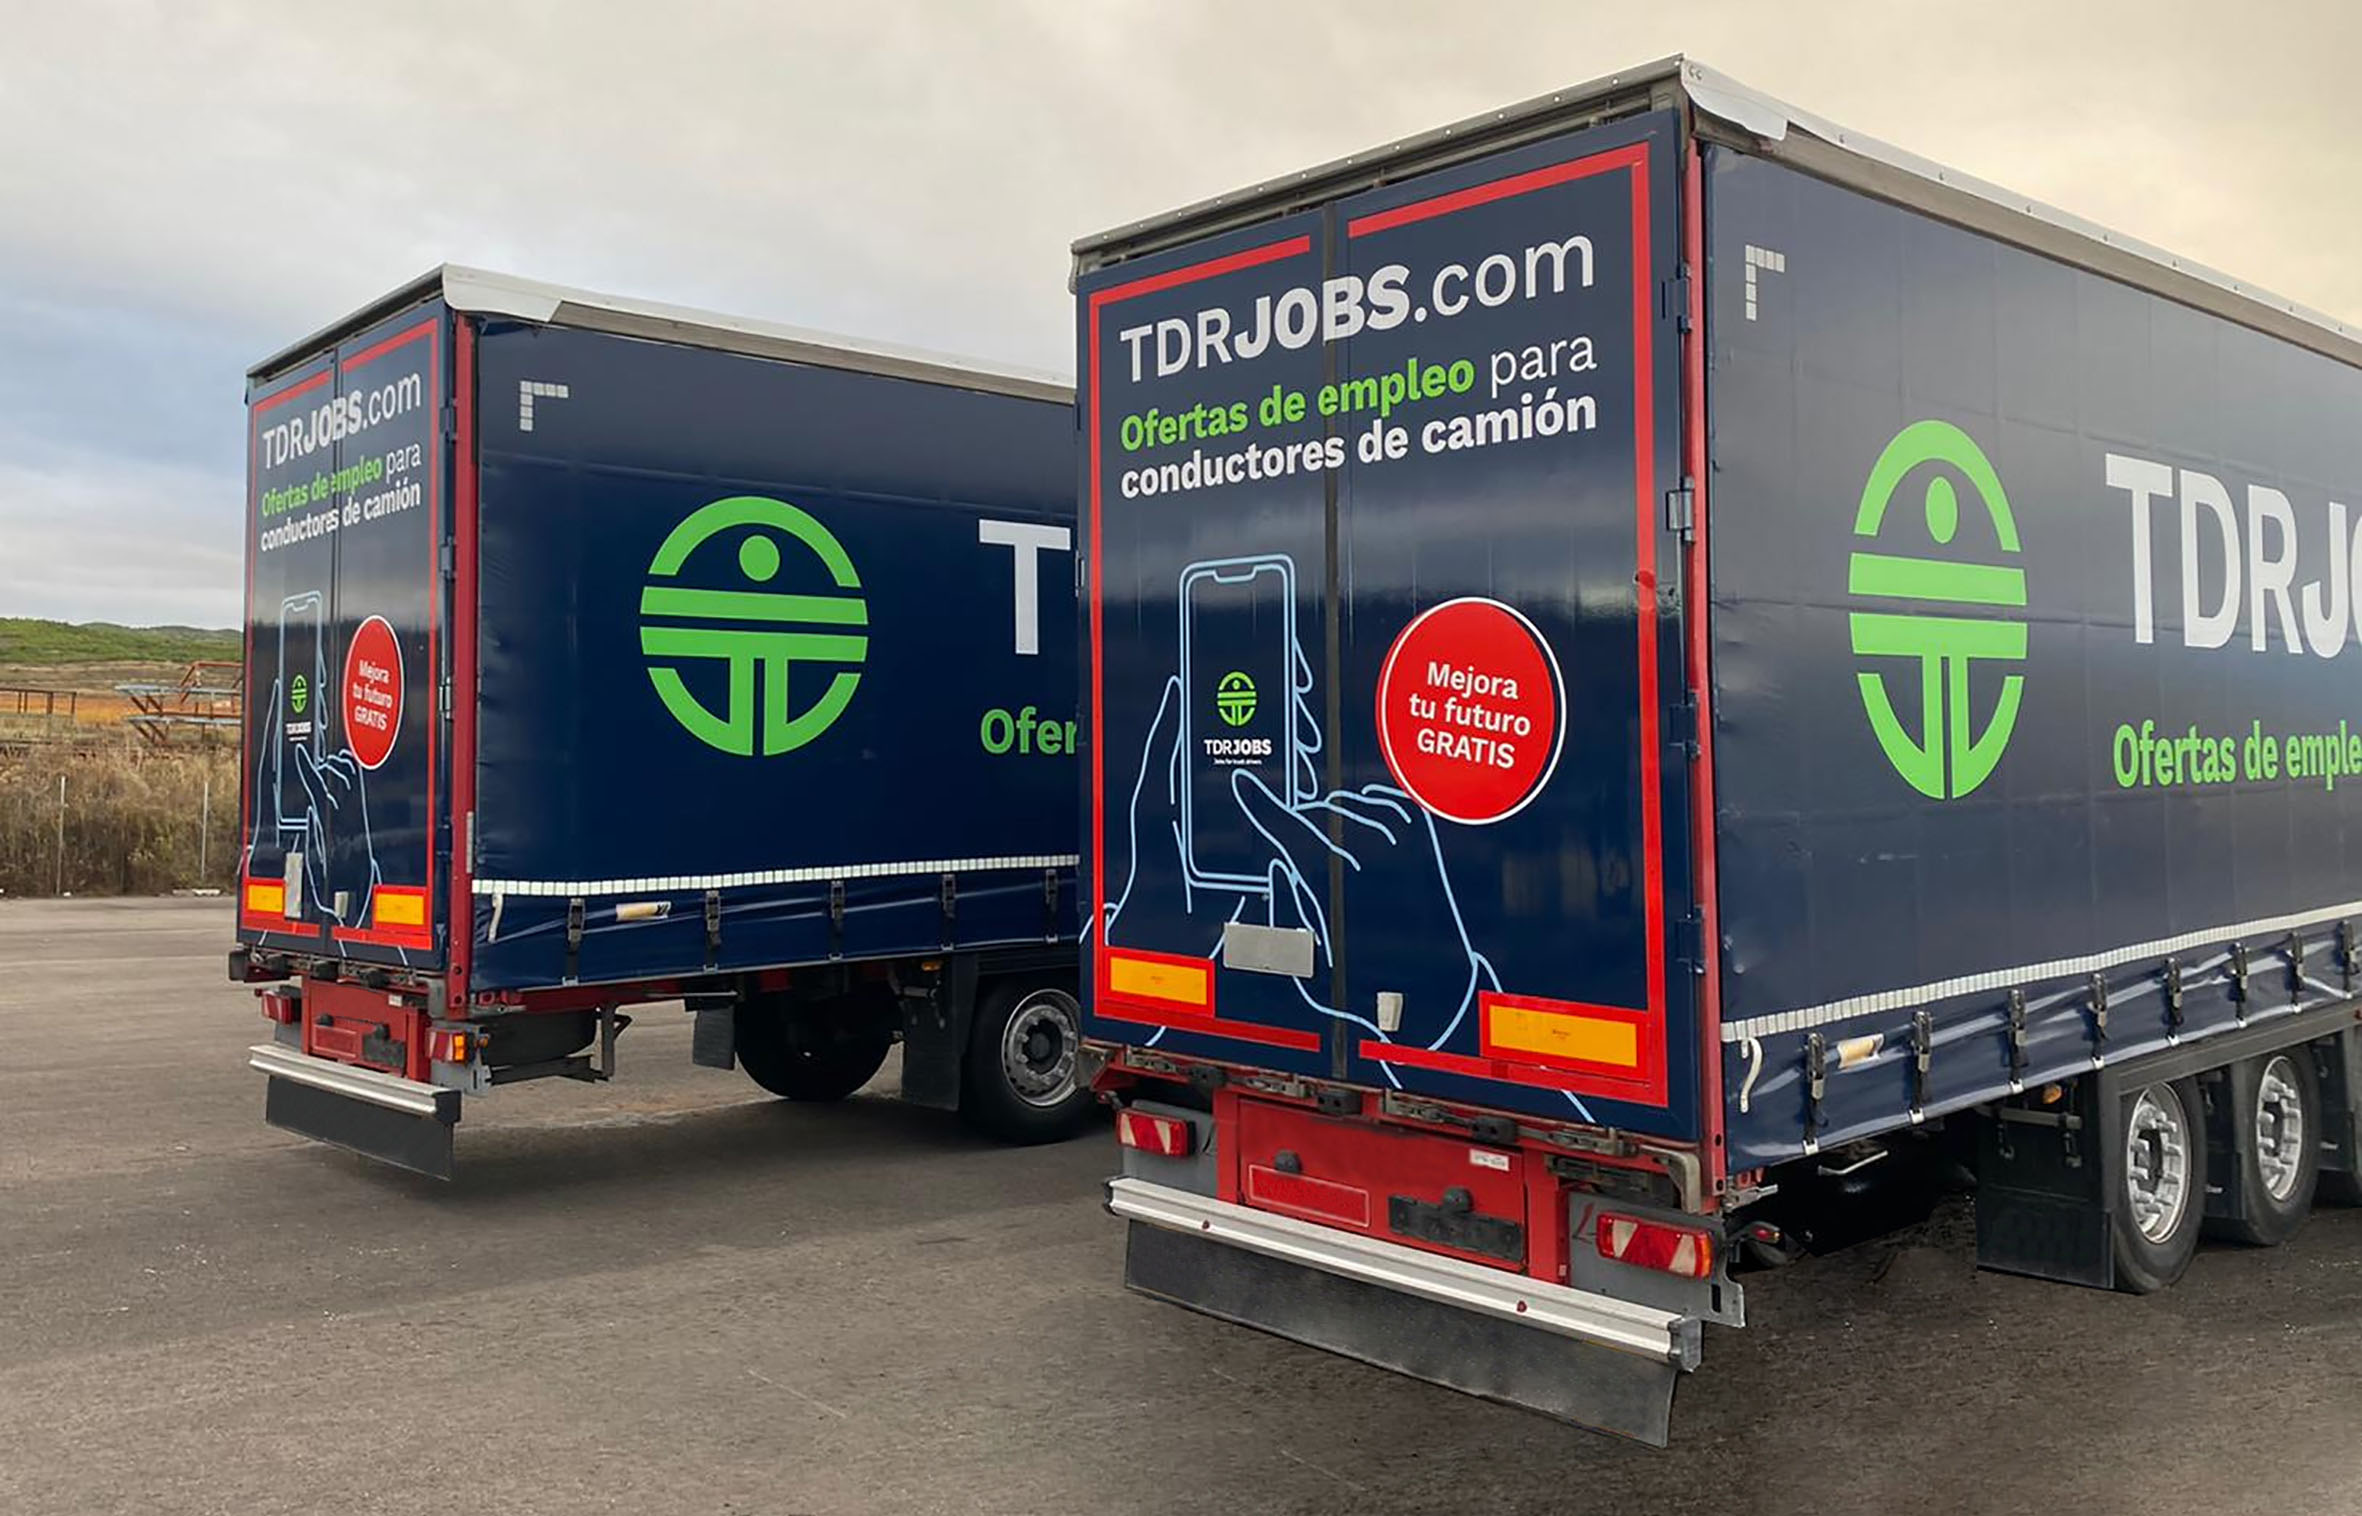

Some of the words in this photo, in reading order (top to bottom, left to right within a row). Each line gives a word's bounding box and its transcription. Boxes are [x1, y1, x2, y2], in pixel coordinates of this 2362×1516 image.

[1119, 234, 1595, 383] TDRJOBS.com
[262, 373, 421, 470] TDRJOBS.com
[1121, 402, 1248, 452] Ofertas
[1258, 385, 1307, 428] de
[1317, 359, 1477, 418] empleo
[1490, 336, 1598, 399] para
[262, 484, 308, 517] Ofertas
[311, 471, 330, 500] de
[331, 455, 382, 495] empleo
[386, 443, 421, 483] para
[1121, 438, 1345, 499] conductores
[1357, 419, 1409, 464] de
[1421, 387, 1597, 454] camión
[261, 507, 340, 552] conductores
[342, 496, 361, 527] de
[363, 477, 421, 520] camión
[2105, 453, 2362, 659] TDRJ
[1409, 693, 1436, 719] tu
[1444, 696, 1531, 736] futuro
[1427, 661, 1519, 699] Mejora
[1203, 738, 1273, 756] TDRJOBS
[1417, 728, 1515, 769] GRATIS
[2113, 719, 2237, 788] Ofertas
[2244, 719, 2279, 781] de
